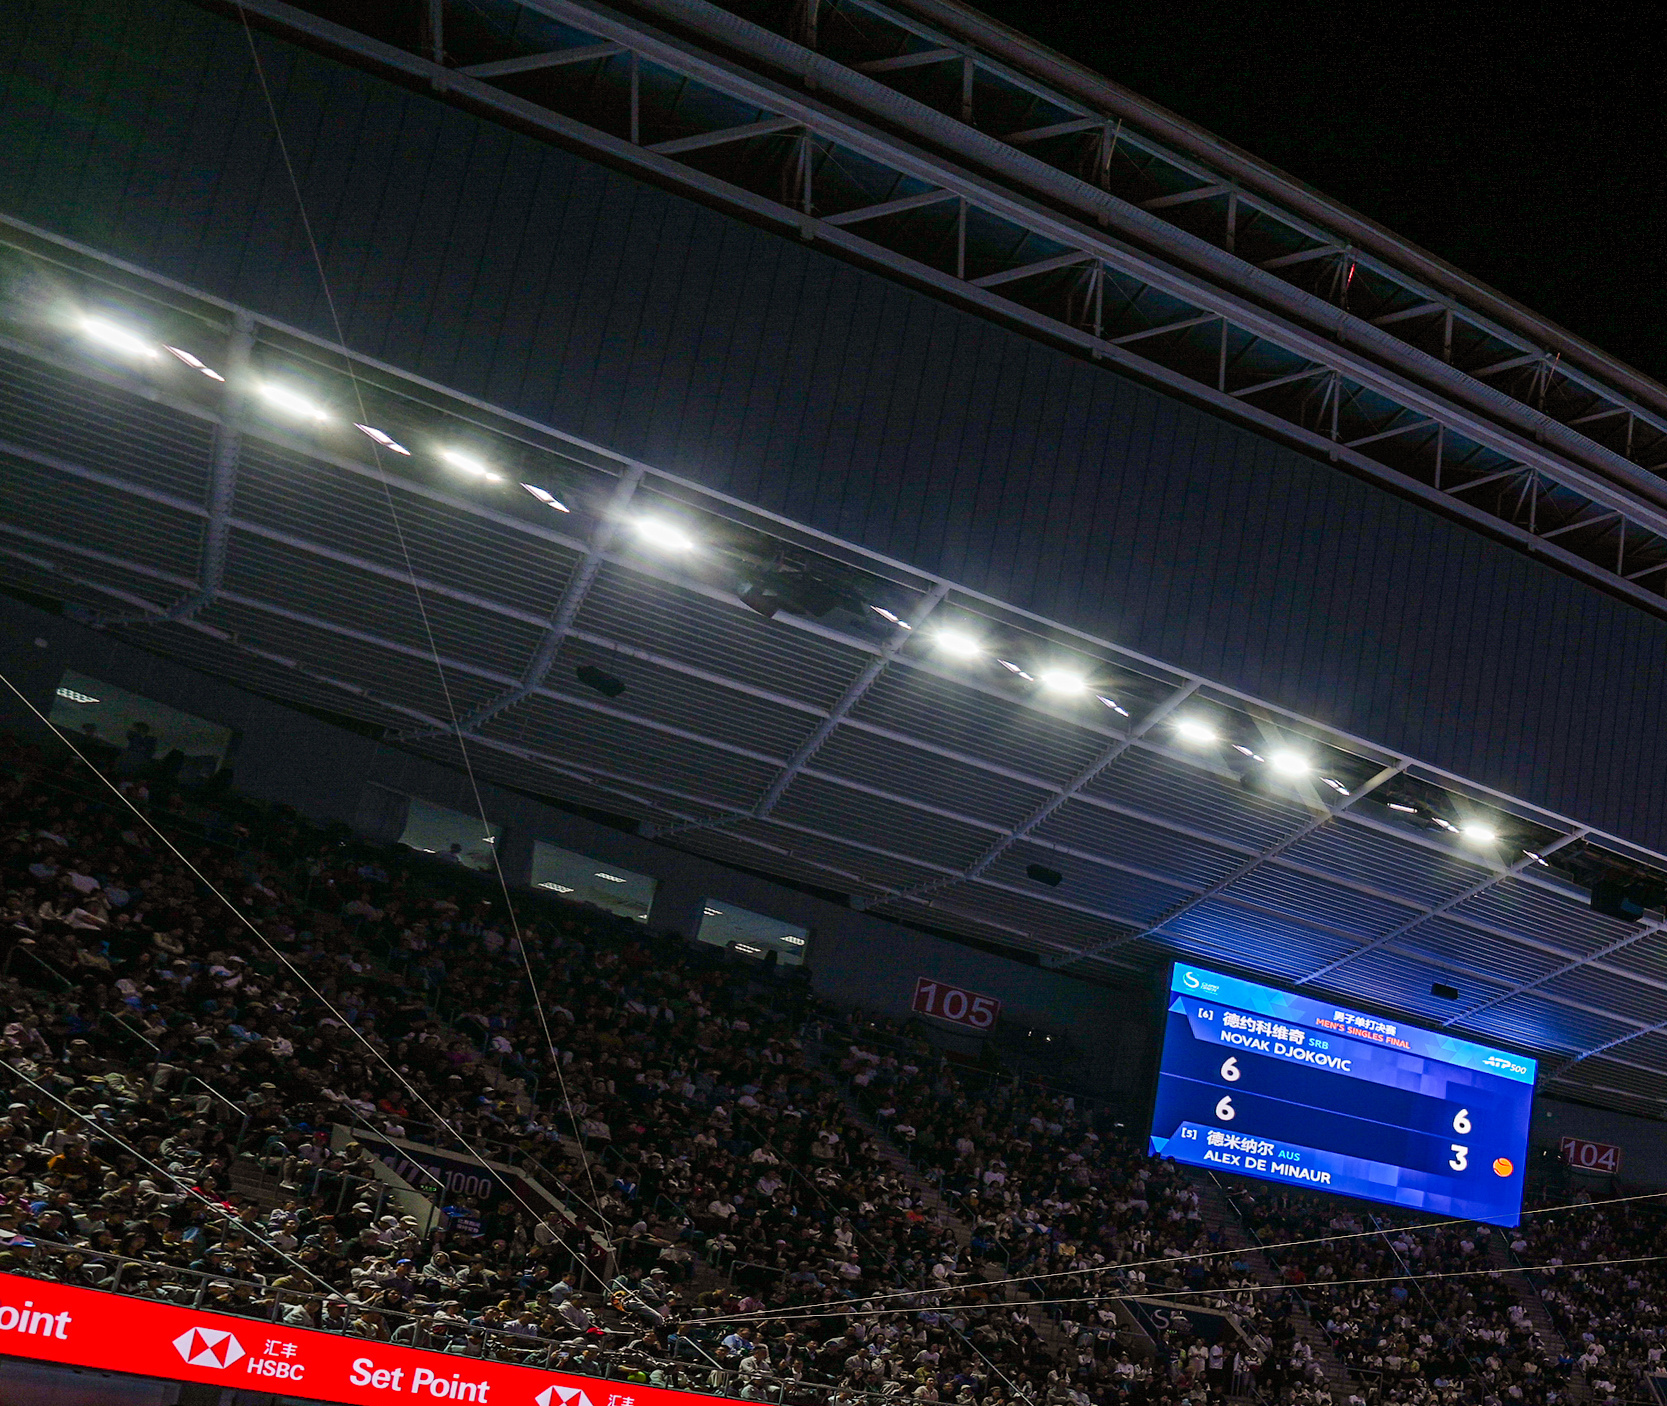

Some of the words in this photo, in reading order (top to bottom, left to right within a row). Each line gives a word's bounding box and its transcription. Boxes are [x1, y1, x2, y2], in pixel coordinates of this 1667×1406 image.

[920, 983, 995, 1028] 105
[1198, 1008, 1214, 1020] [6]
[1222, 1011, 1305, 1045] 德约科维奇
[1316, 1017, 1345, 1032] MEN'S
[1346, 1026, 1384, 1042] SINGLES
[1385, 1035, 1411, 1049] FINAL
[1333, 1010, 1397, 1036] 男子单打决赛
[1220, 1030, 1270, 1052] NOVAK
[1273, 1042, 1352, 1072] DJOKOVIC
[1308, 1037, 1329, 1050] SRB
[1221, 1057, 1240, 1081] 6
[1482, 1055, 1511, 1069] ATP
[1510, 1063, 1528, 1075] 500
[1216, 1096, 1235, 1120] 6
[1181, 1127, 1198, 1140] [5]
[1453, 1109, 1471, 1134] 6
[1206, 1130, 1275, 1156] 德米纳尔
[1278, 1150, 1301, 1162] AUS
[1565, 1140, 1616, 1171] 104
[1203, 1150, 1241, 1167] ALEX
[1244, 1157, 1268, 1173] DE
[1271, 1162, 1332, 1185] MINAUR
[1449, 1144, 1468, 1171] 3
[0, 1301, 72, 1339] oint
[350, 1358, 404, 1391] Set
[411, 1368, 490, 1403] Point
